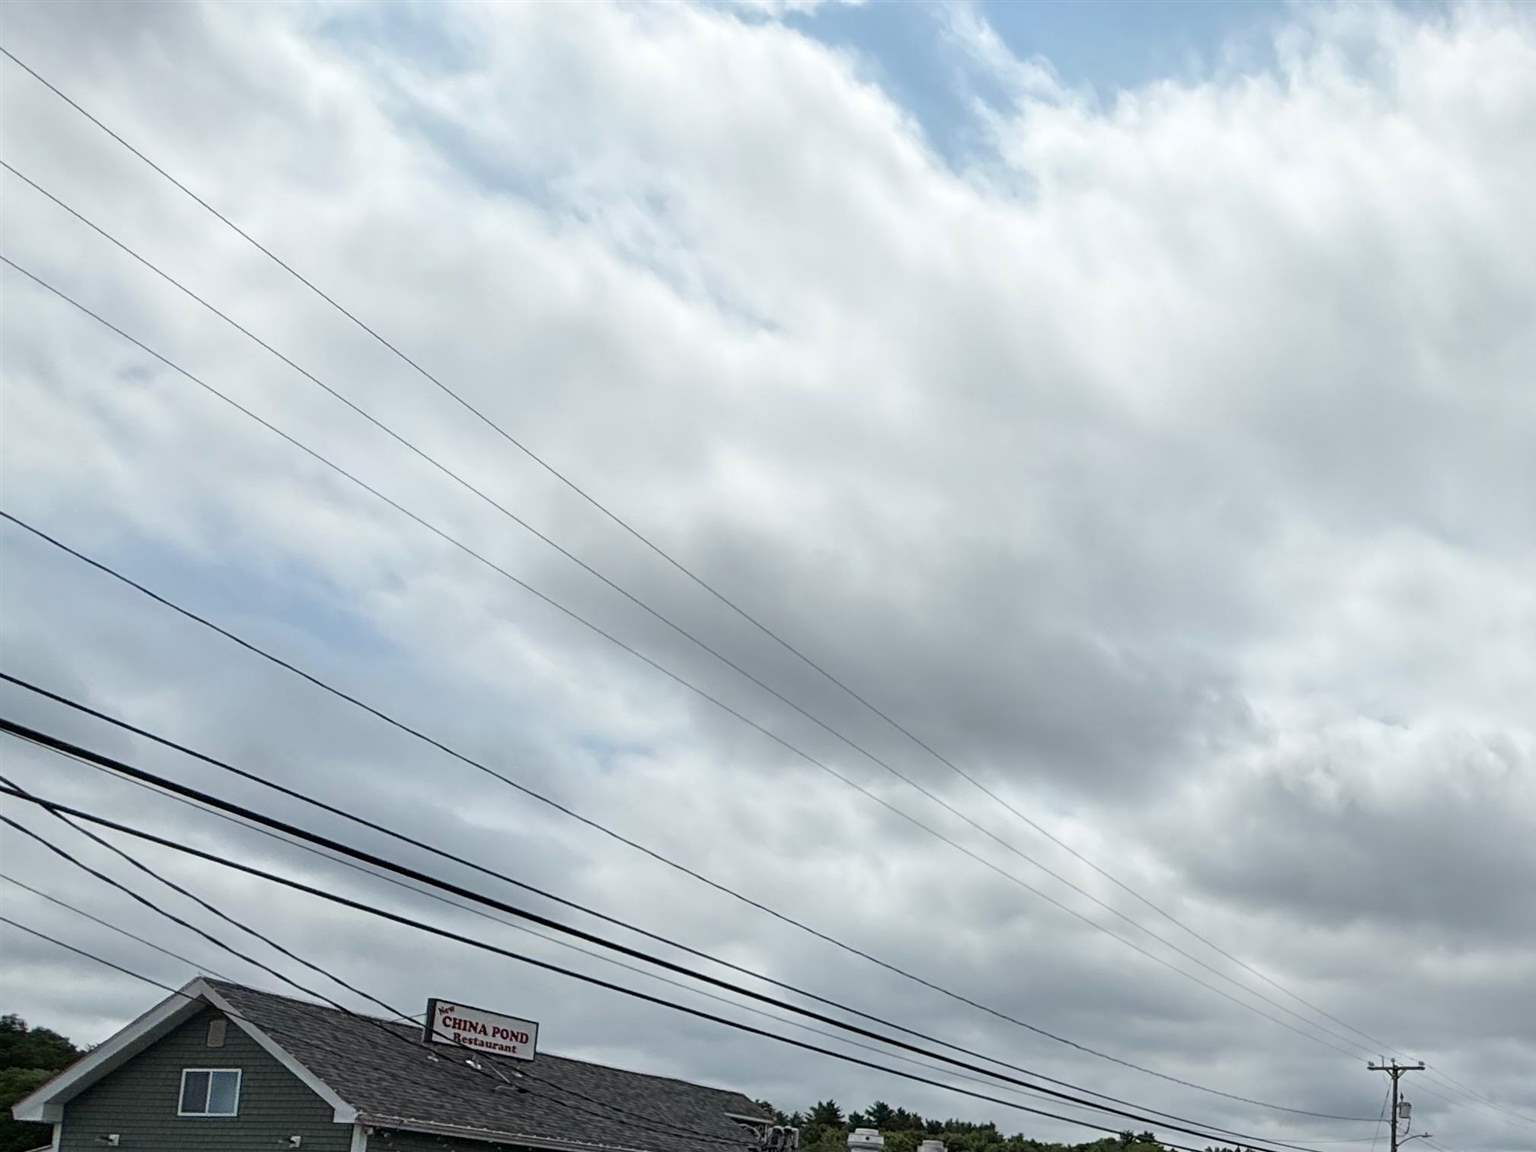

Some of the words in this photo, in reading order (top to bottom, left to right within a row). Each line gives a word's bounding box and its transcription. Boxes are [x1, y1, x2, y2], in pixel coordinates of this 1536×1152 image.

[442, 1016, 488, 1036] CHINA
[492, 1026, 529, 1044] POND
[453, 1032, 517, 1053] Restaurant
